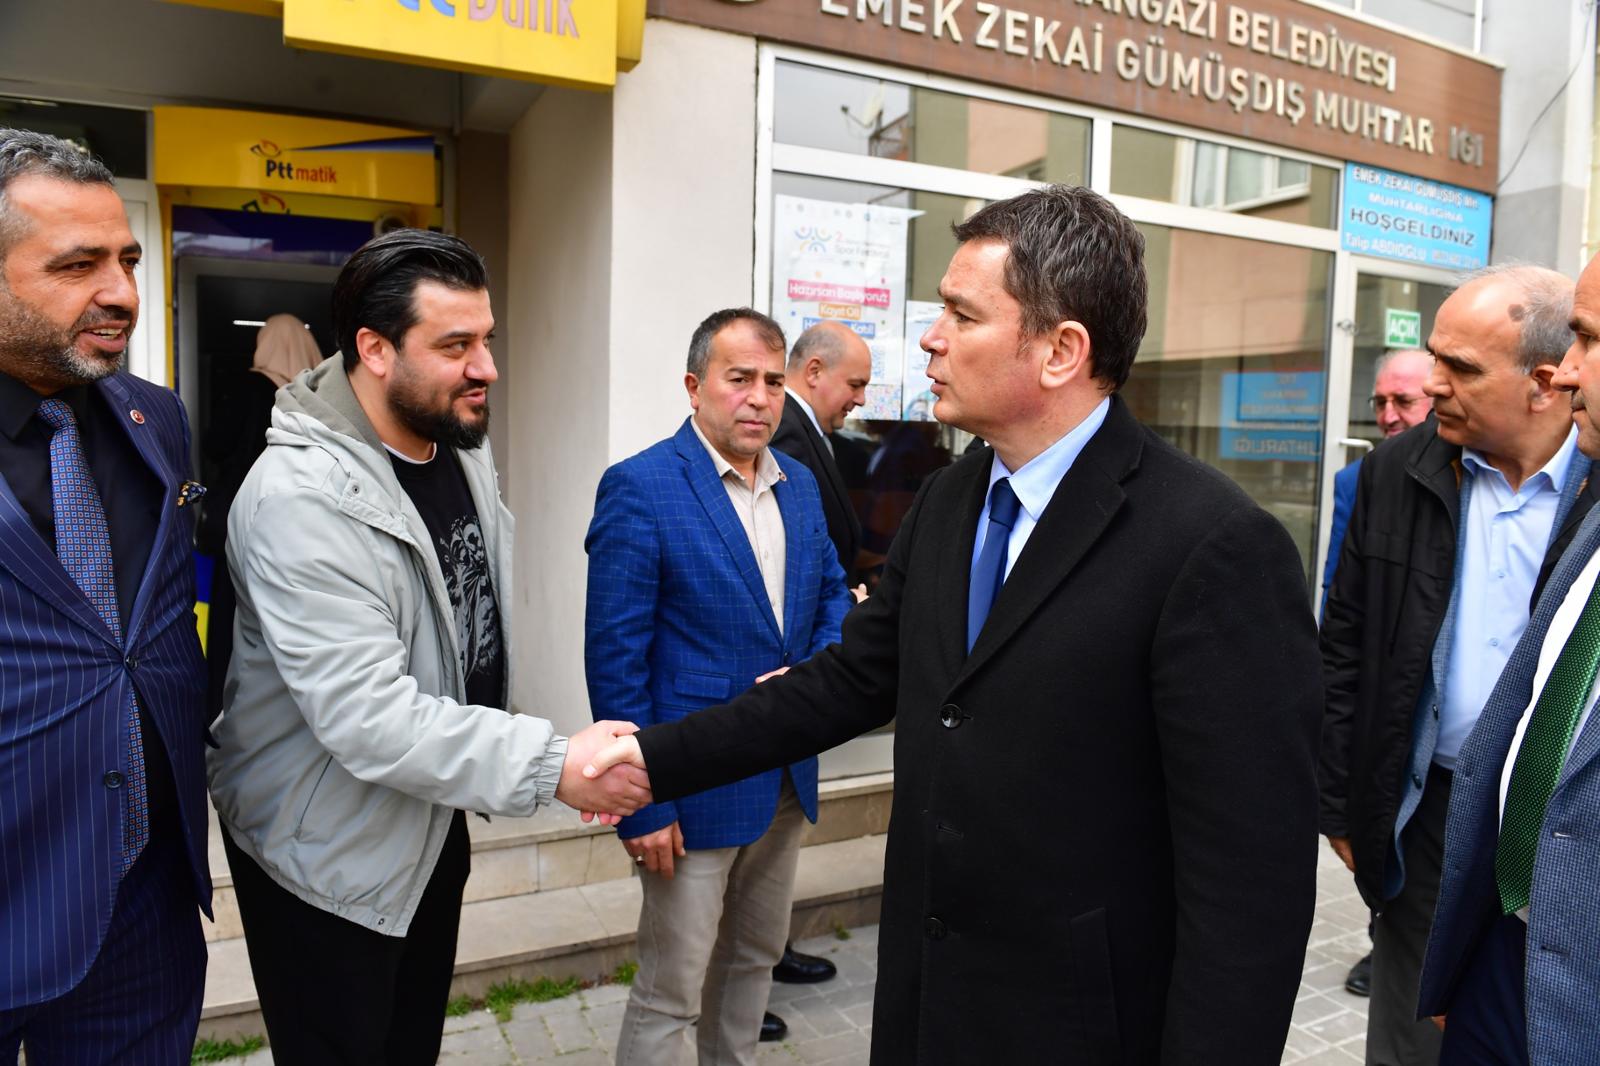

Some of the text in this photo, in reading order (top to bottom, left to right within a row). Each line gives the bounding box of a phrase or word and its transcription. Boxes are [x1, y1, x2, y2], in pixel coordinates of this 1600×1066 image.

[975, 2, 1103, 74] ZEKAİ
[1115, 35, 1306, 125] GÜMÜŞDIŞ
[1313, 88, 1435, 154] MUHTAR
[1388, 318, 1418, 343] AÇIK
